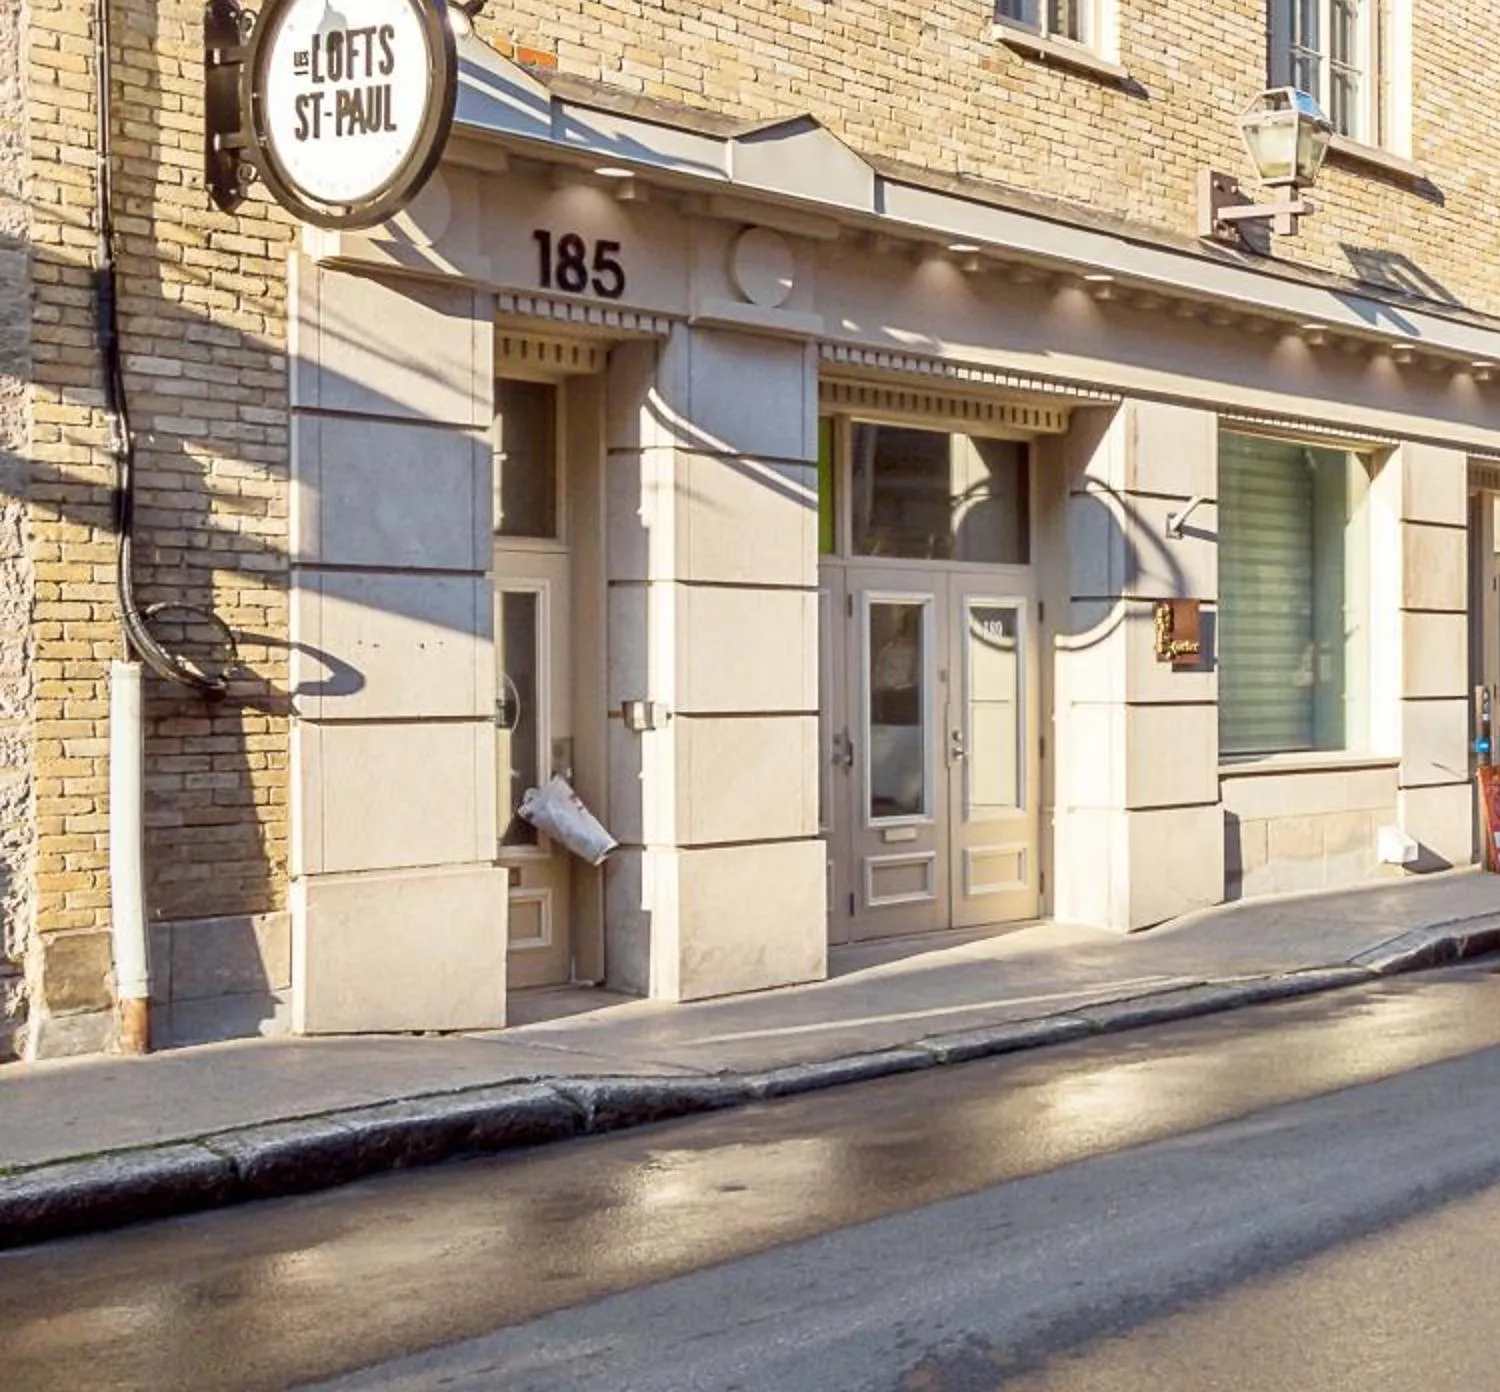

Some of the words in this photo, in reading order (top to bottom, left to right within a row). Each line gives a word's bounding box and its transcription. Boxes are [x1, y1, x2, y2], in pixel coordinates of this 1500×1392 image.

[312, 24, 394, 83] LOFTS
[295, 84, 397, 142] ST-PAUL
[532, 229, 625, 300] 185
